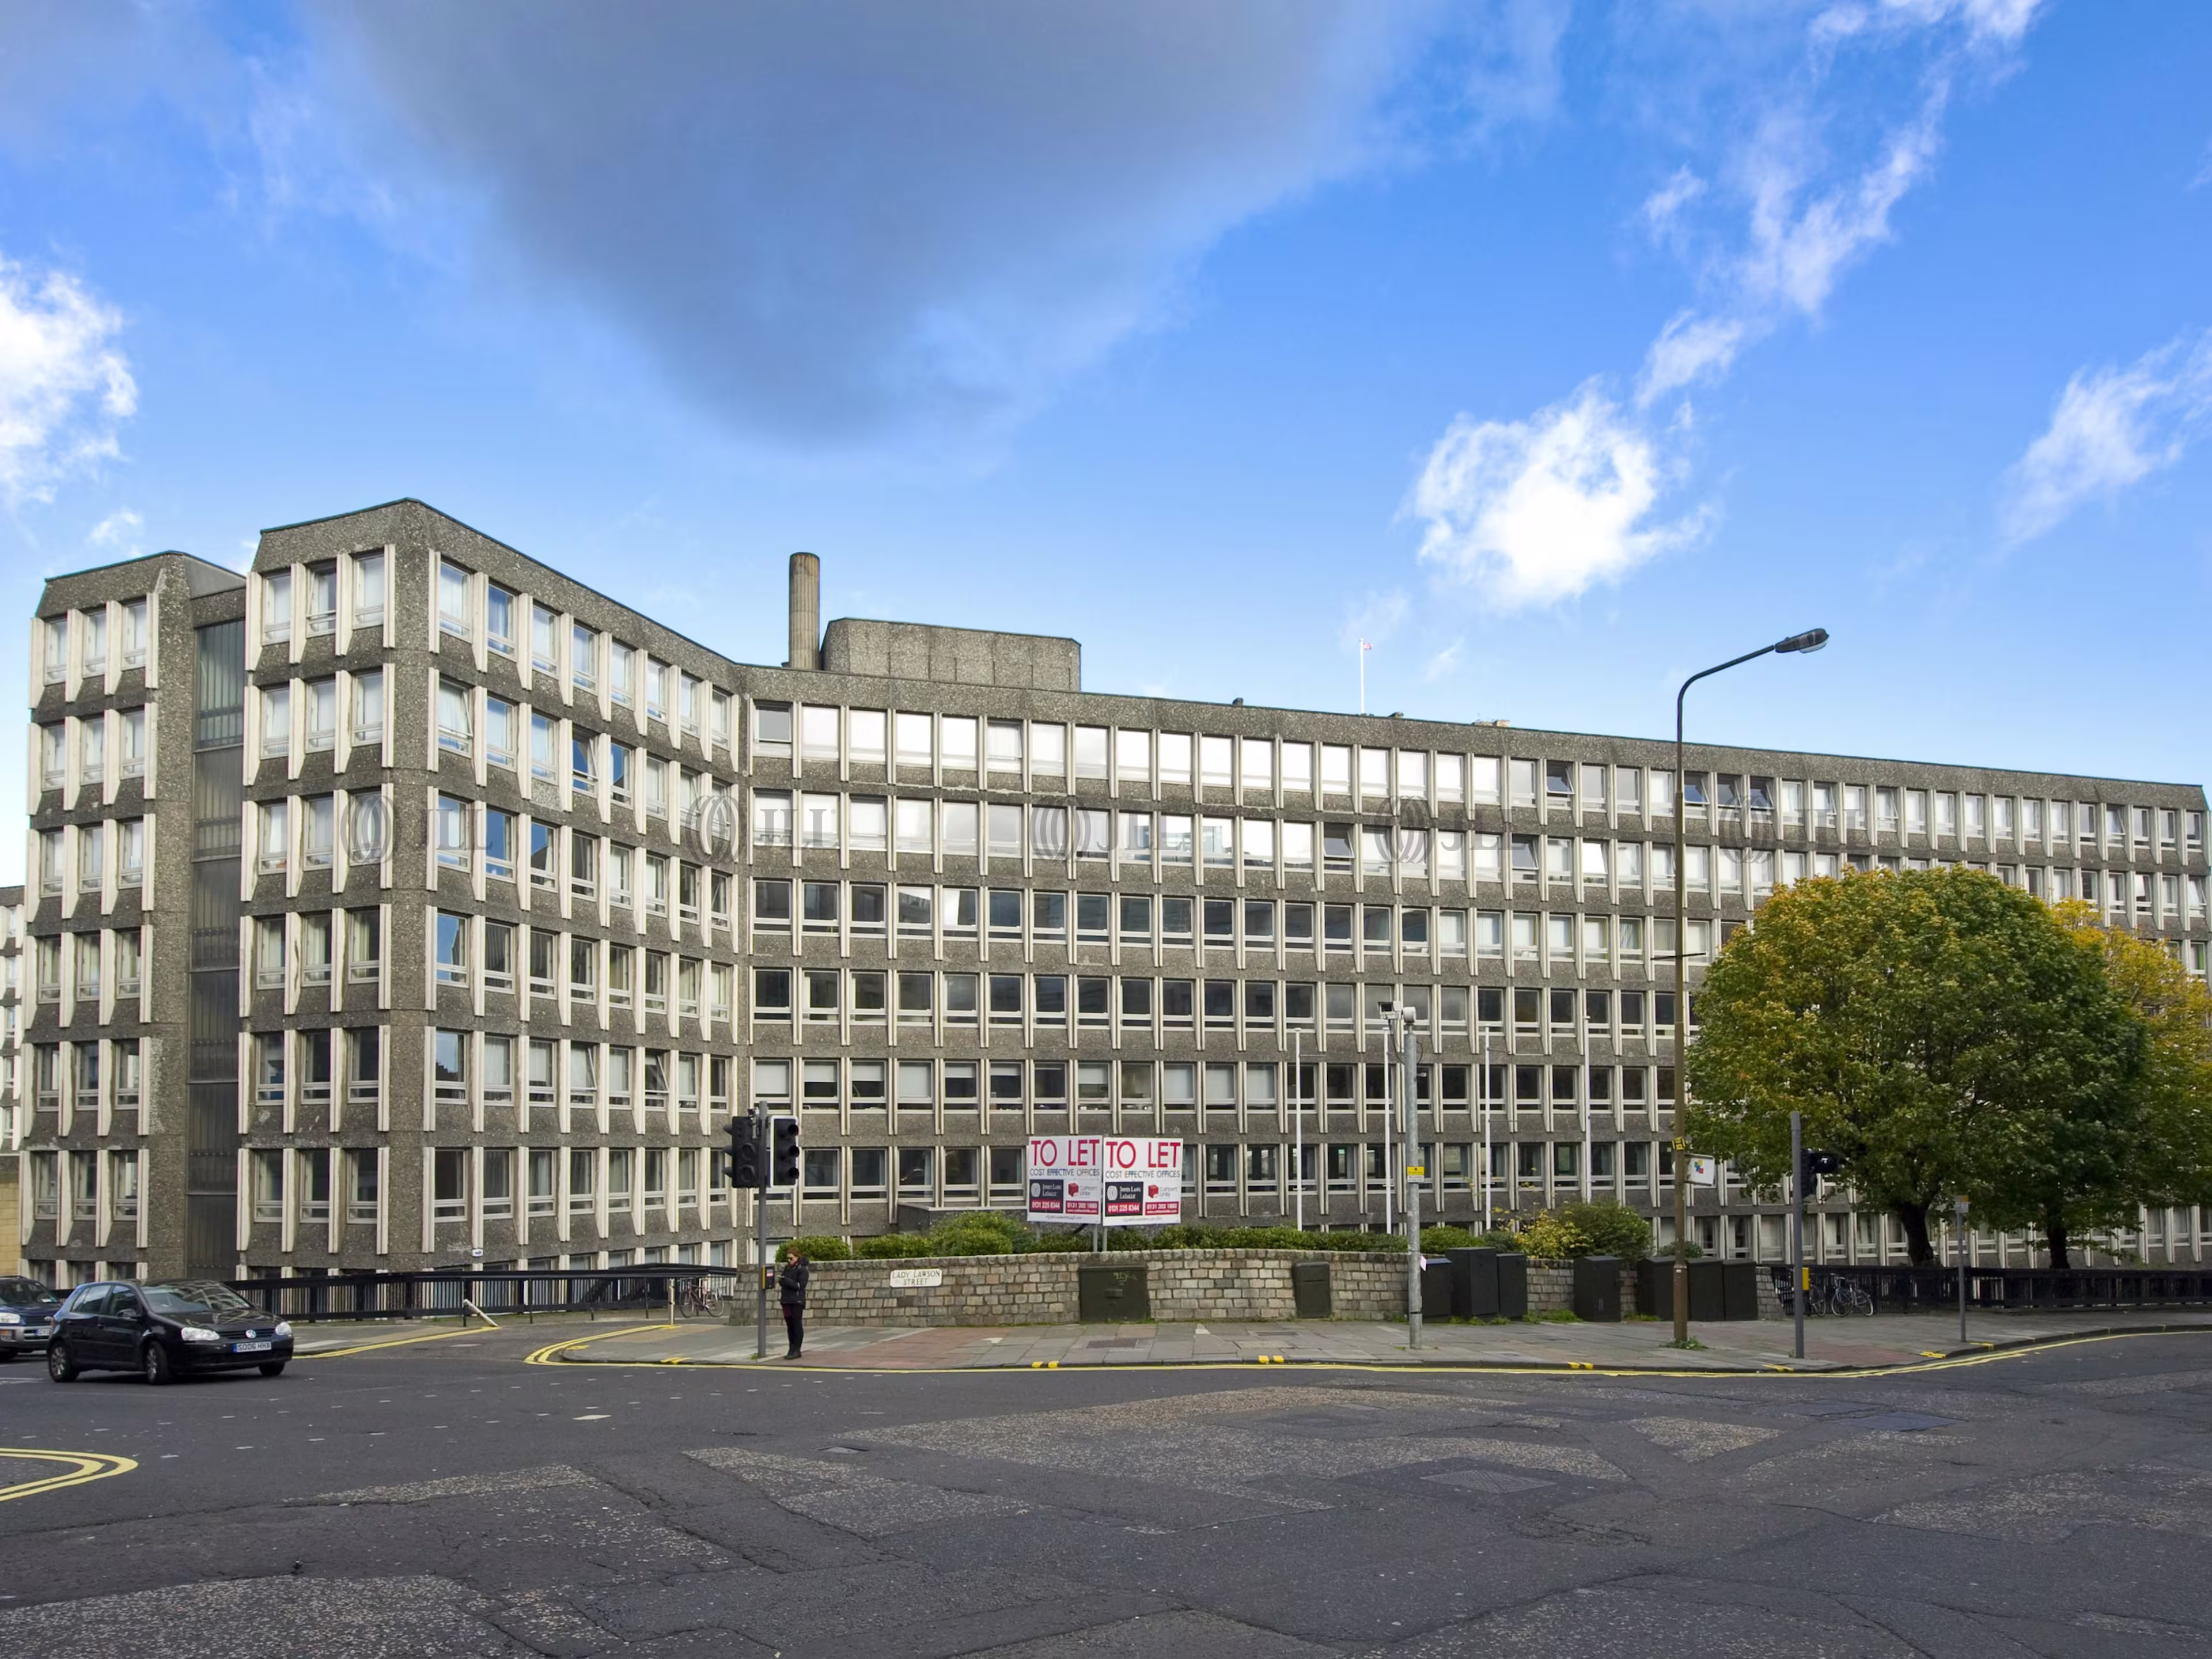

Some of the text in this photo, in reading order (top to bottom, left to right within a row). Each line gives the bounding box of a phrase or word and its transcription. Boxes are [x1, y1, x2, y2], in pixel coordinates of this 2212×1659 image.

[1031, 1139, 1100, 1166] TO LET
[1106, 1141, 1181, 1168] TO LET
[1105, 1171, 1122, 1179] COST
[914, 1270, 940, 1278] LAWSON
